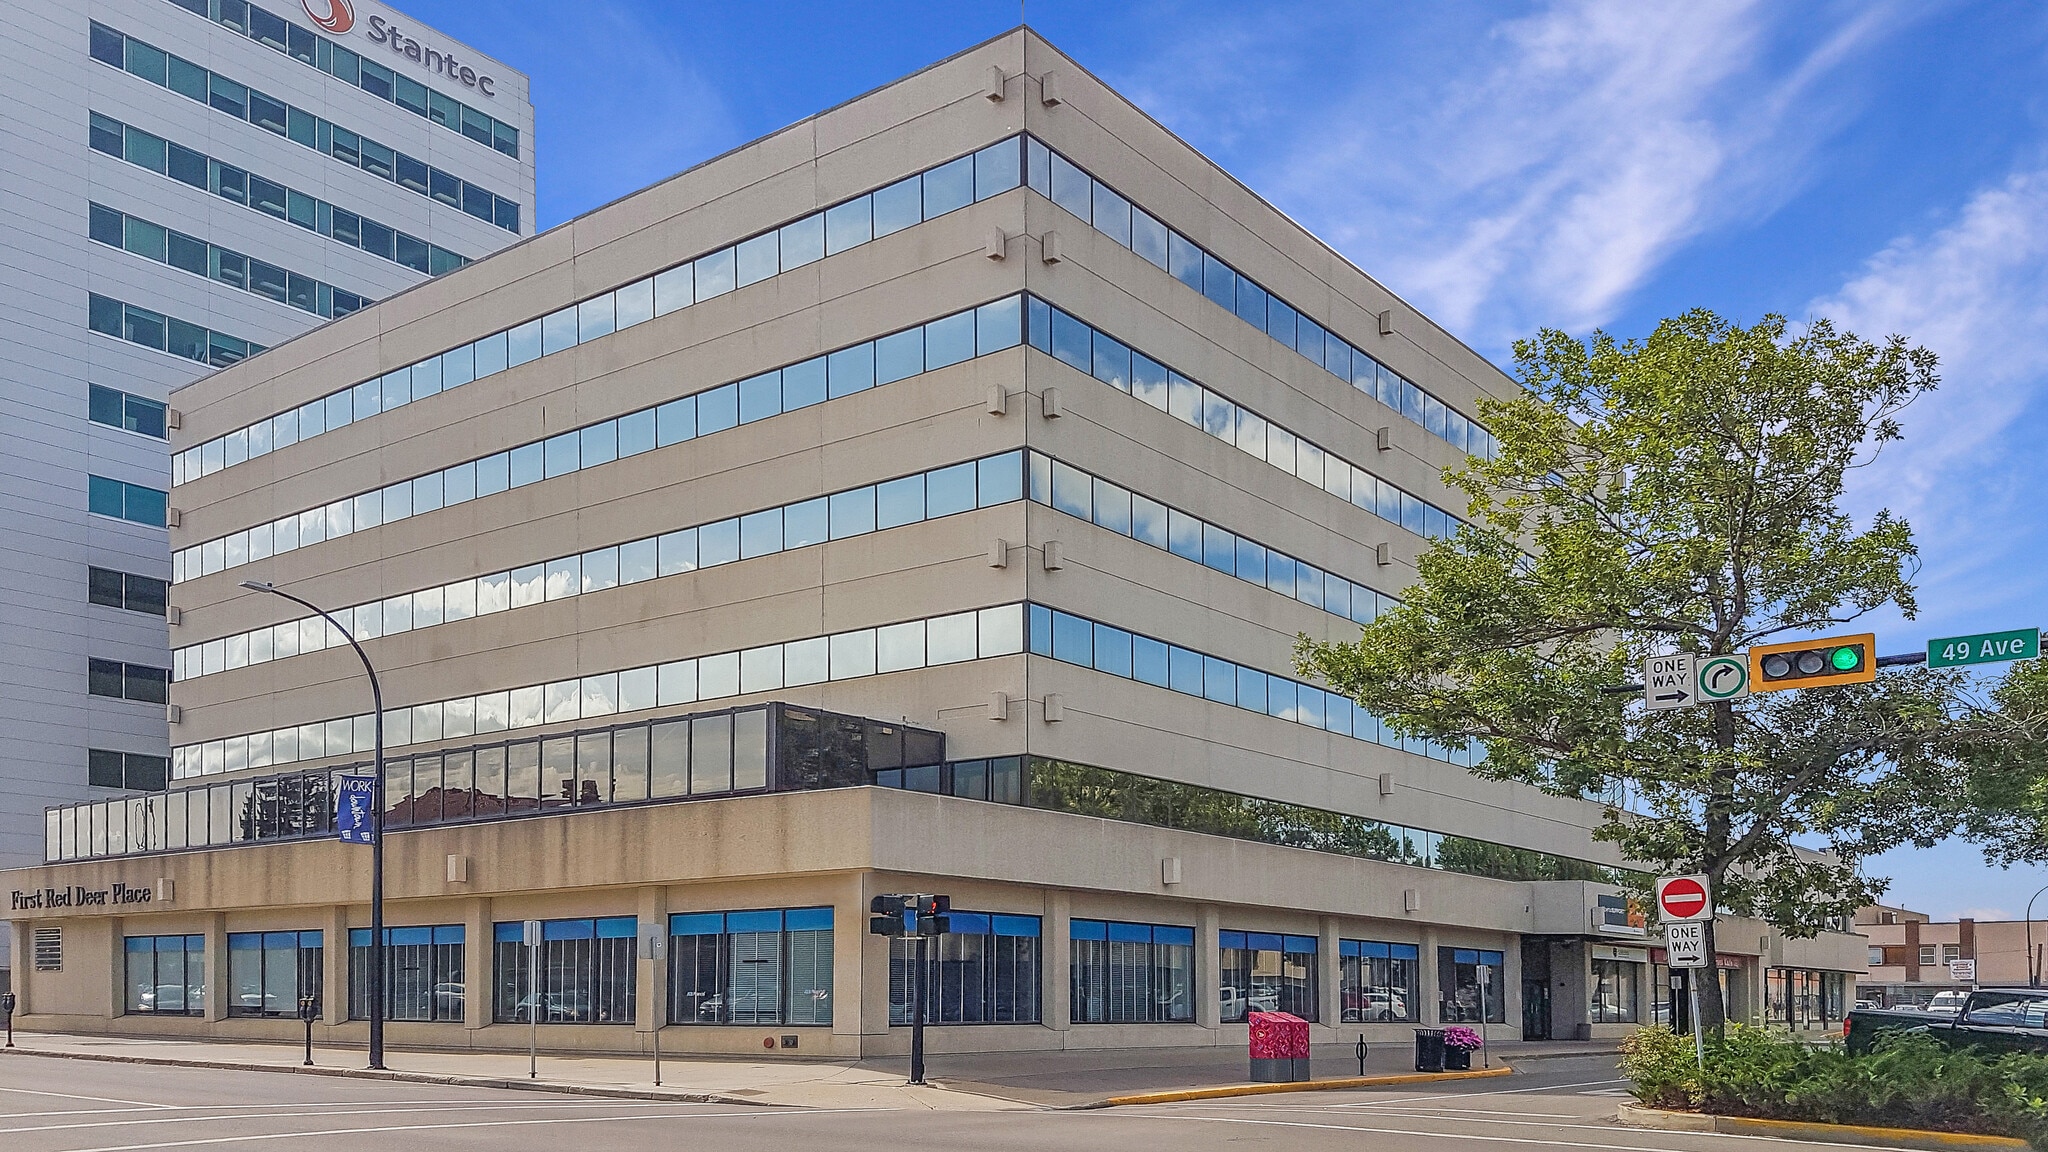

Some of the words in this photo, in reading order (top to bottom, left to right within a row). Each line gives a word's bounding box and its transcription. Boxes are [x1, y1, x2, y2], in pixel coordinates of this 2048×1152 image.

[367, 15, 495, 97] Stantec
[1942, 642, 1970, 660] 49
[1980, 639, 2023, 657] Ave
[1653, 658, 1686, 673] ONE
[1652, 672, 1687, 687] WAY
[342, 779, 372, 792] WORK
[11, 889, 43, 910] First
[45, 886, 72, 908] Red
[75, 886, 108, 906] Deer
[112, 882, 151, 904] Place
[1671, 927, 1698, 938] ONE
[1672, 940, 1699, 952] WAY
